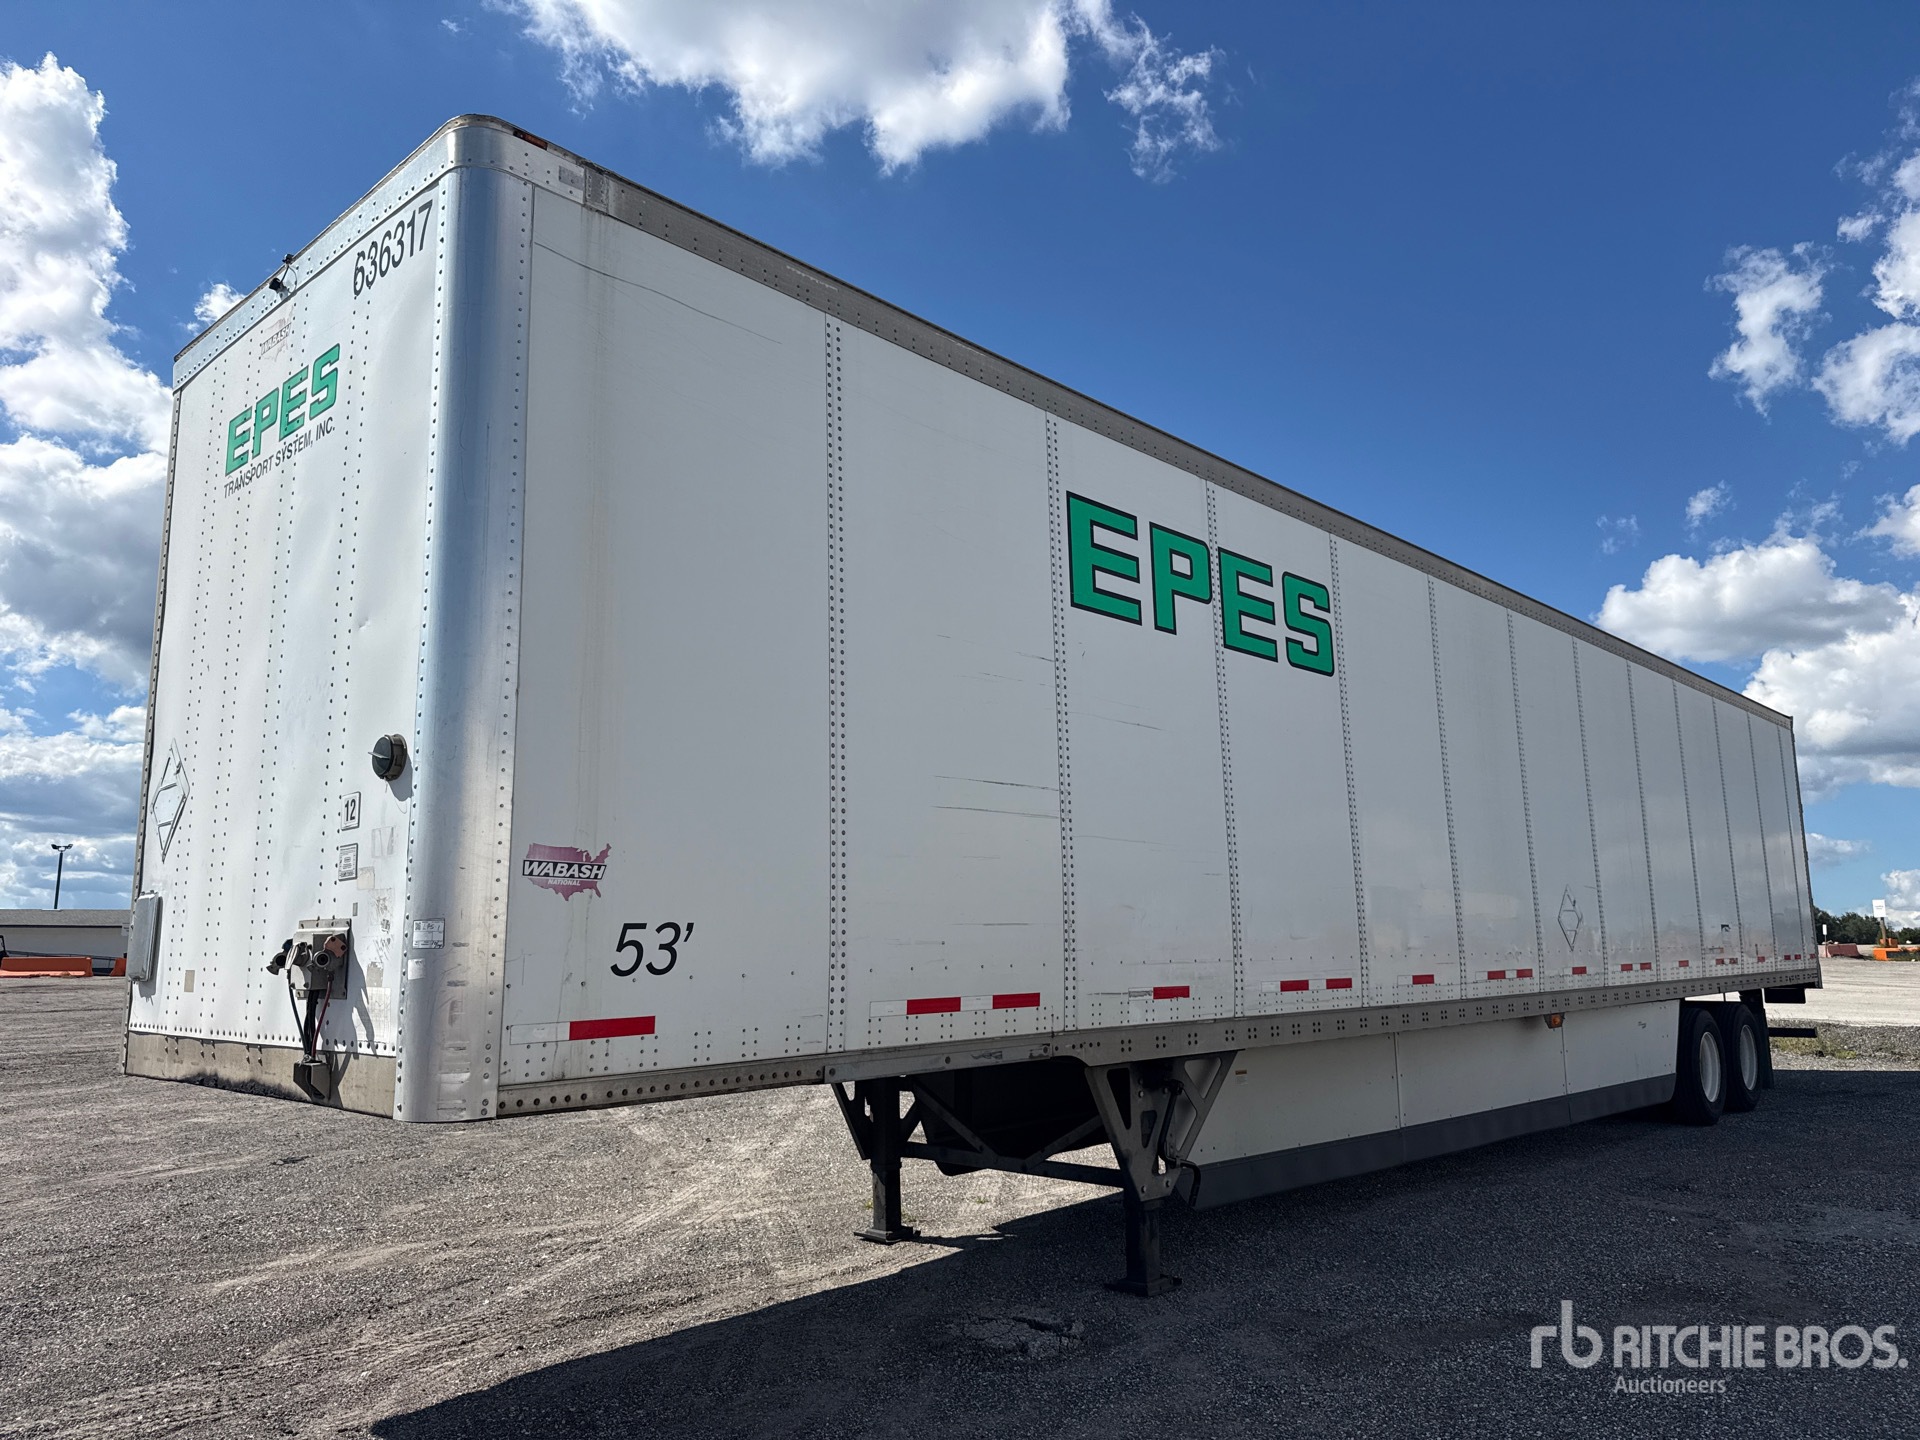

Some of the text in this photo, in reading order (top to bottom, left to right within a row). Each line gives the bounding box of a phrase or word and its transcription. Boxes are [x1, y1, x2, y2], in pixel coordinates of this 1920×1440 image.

[354, 199, 432, 296] 636317
[225, 343, 340, 476] EPES
[224, 417, 335, 498] TRANSPORT SYSTEM, INC.
[1066, 490, 1335, 677] EPES
[344, 798, 356, 821] 12
[523, 860, 606, 879] WABASH
